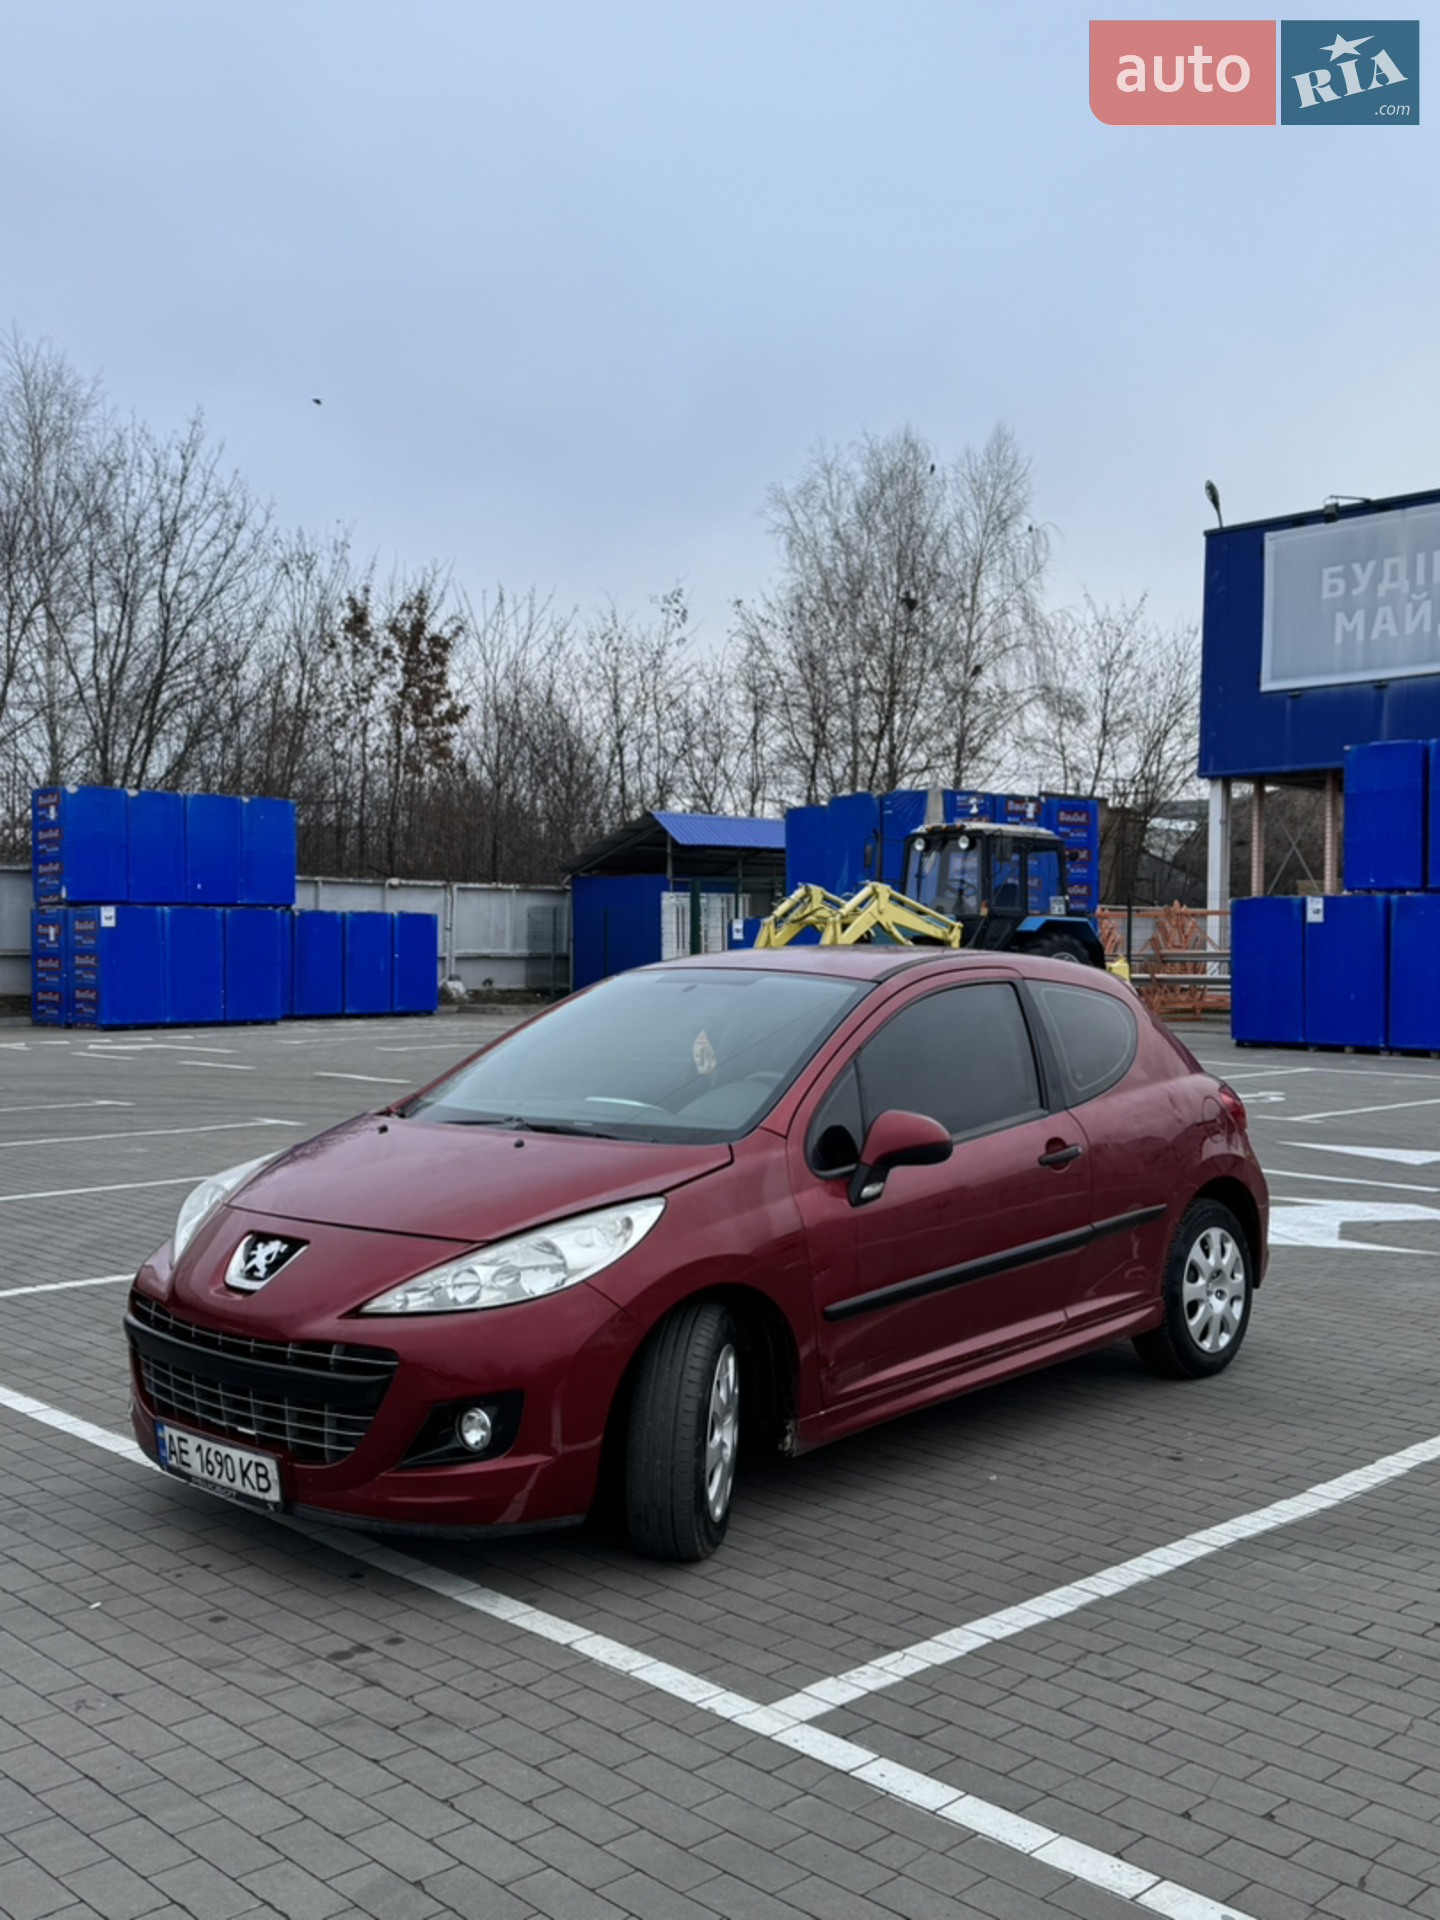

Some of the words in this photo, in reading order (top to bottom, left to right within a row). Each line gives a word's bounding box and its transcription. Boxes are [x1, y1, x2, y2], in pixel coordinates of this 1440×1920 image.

[1334, 591, 1440, 645] МАЙ
[168, 1433, 192, 1468] AE
[195, 1443, 236, 1484] 1690
[239, 1457, 272, 1494] KB
